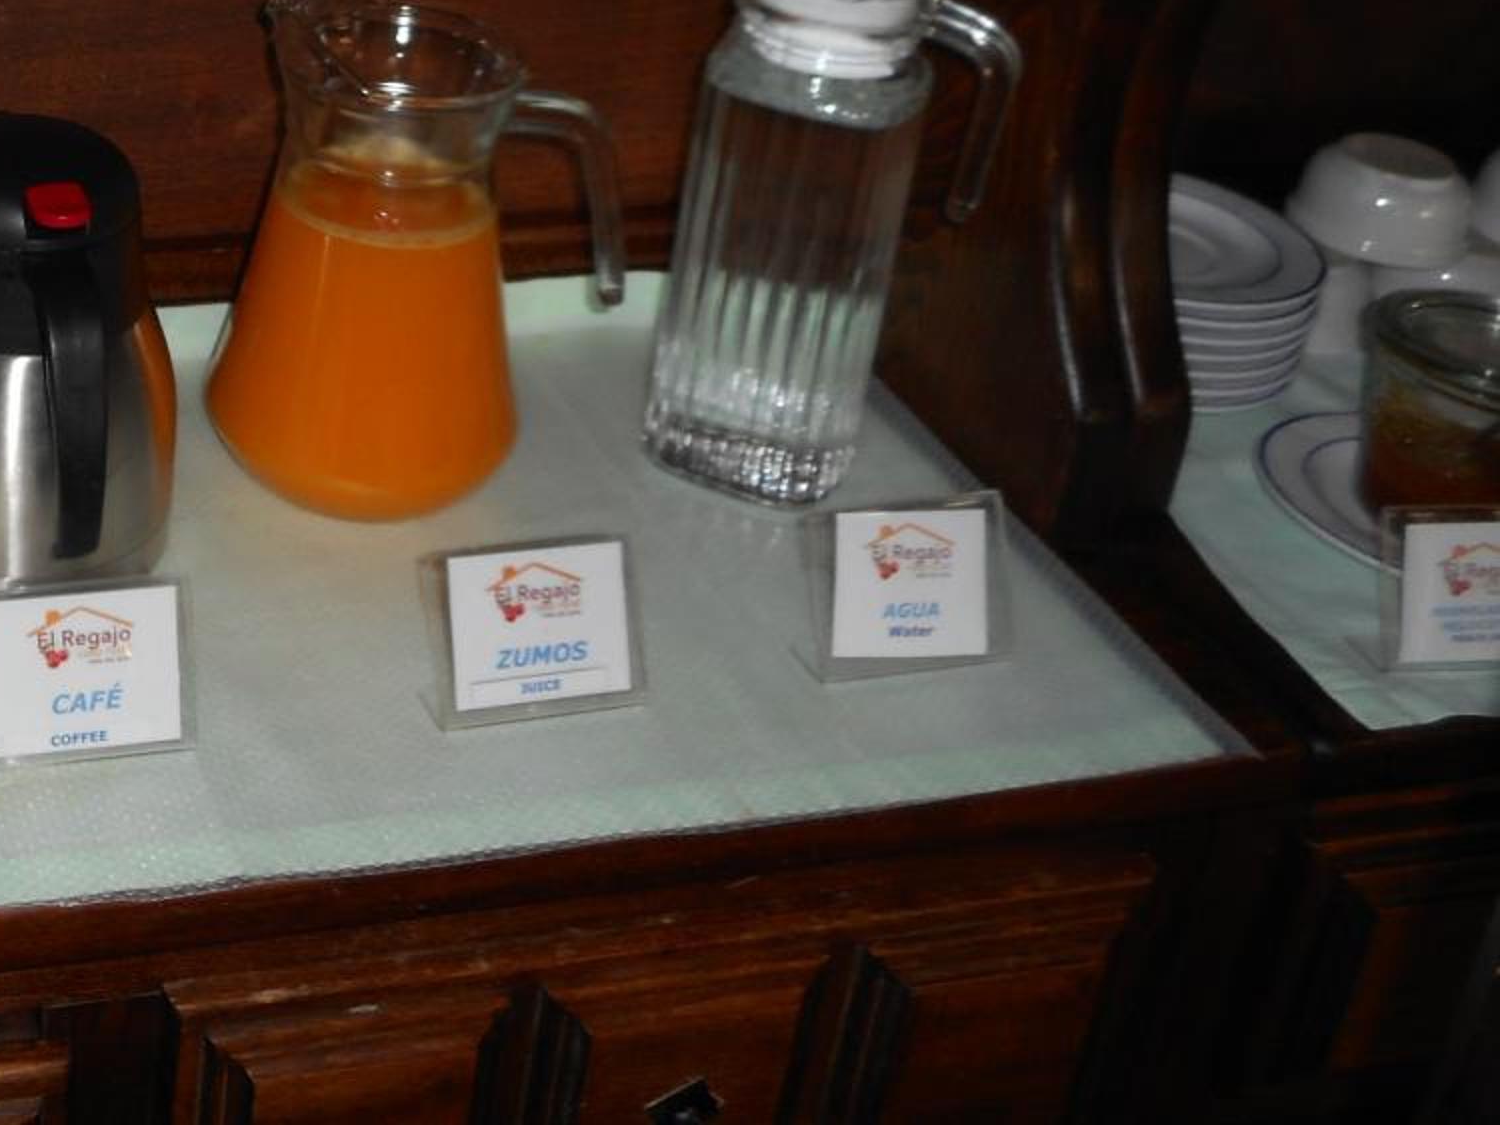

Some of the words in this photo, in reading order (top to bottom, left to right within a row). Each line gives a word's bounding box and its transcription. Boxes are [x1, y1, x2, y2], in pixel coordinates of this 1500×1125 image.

[517, 583, 581, 605] Regajo
[883, 603, 940, 618] AGUA
[37, 632, 55, 650] El
[61, 626, 132, 650] Regajo
[496, 641, 589, 670] ZUMOS
[52, 682, 123, 715] CAFÉ
[51, 730, 108, 748] COFFEE
